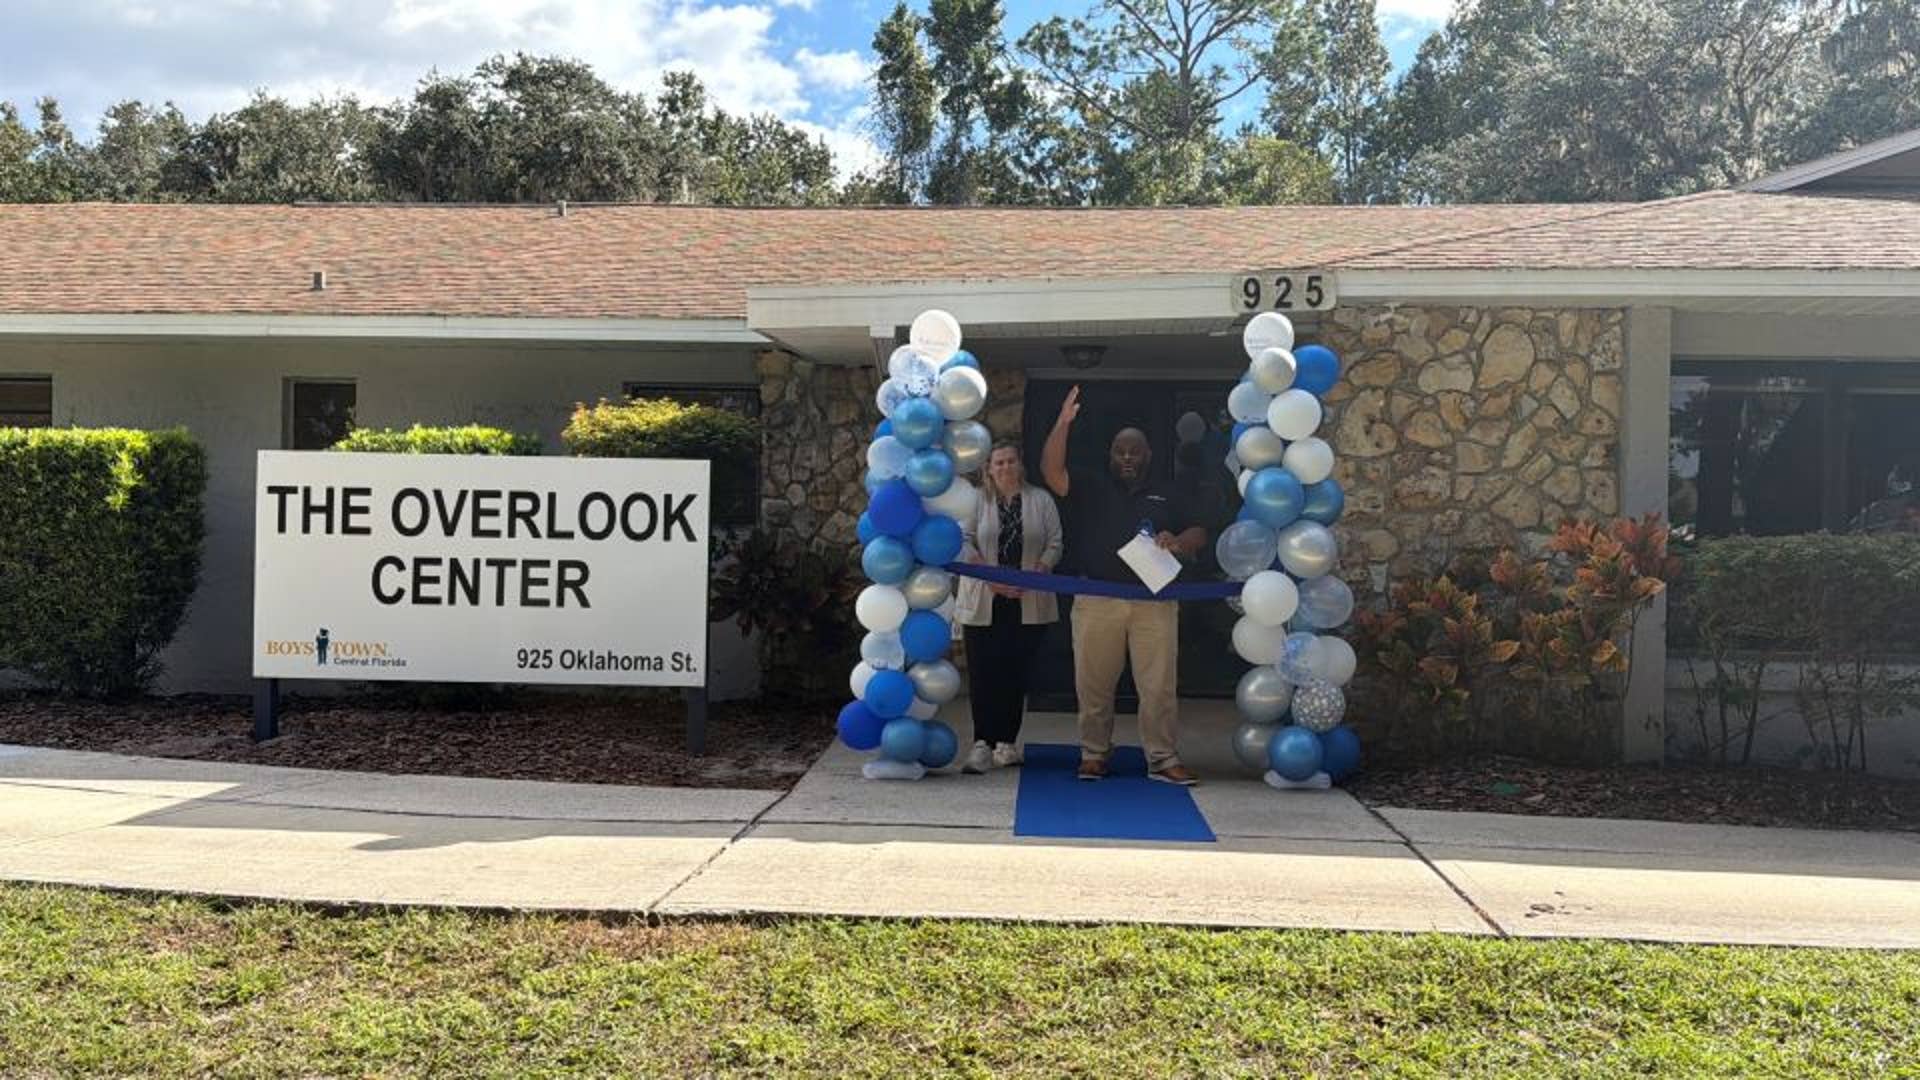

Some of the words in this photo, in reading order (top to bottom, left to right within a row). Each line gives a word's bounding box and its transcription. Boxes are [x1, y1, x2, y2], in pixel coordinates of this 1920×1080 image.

[1243, 275, 1324, 309] 925
[266, 485, 373, 535] THE
[391, 487, 698, 542] OVERLOOK
[371, 555, 591, 608] CENTER
[266, 640, 315, 656] BOYS
[333, 657, 369, 666] Central
[371, 657, 407, 667] Florida
[516, 649, 553, 669] 925
[559, 649, 664, 672] Oklahoma
[671, 651, 697, 673] St.
